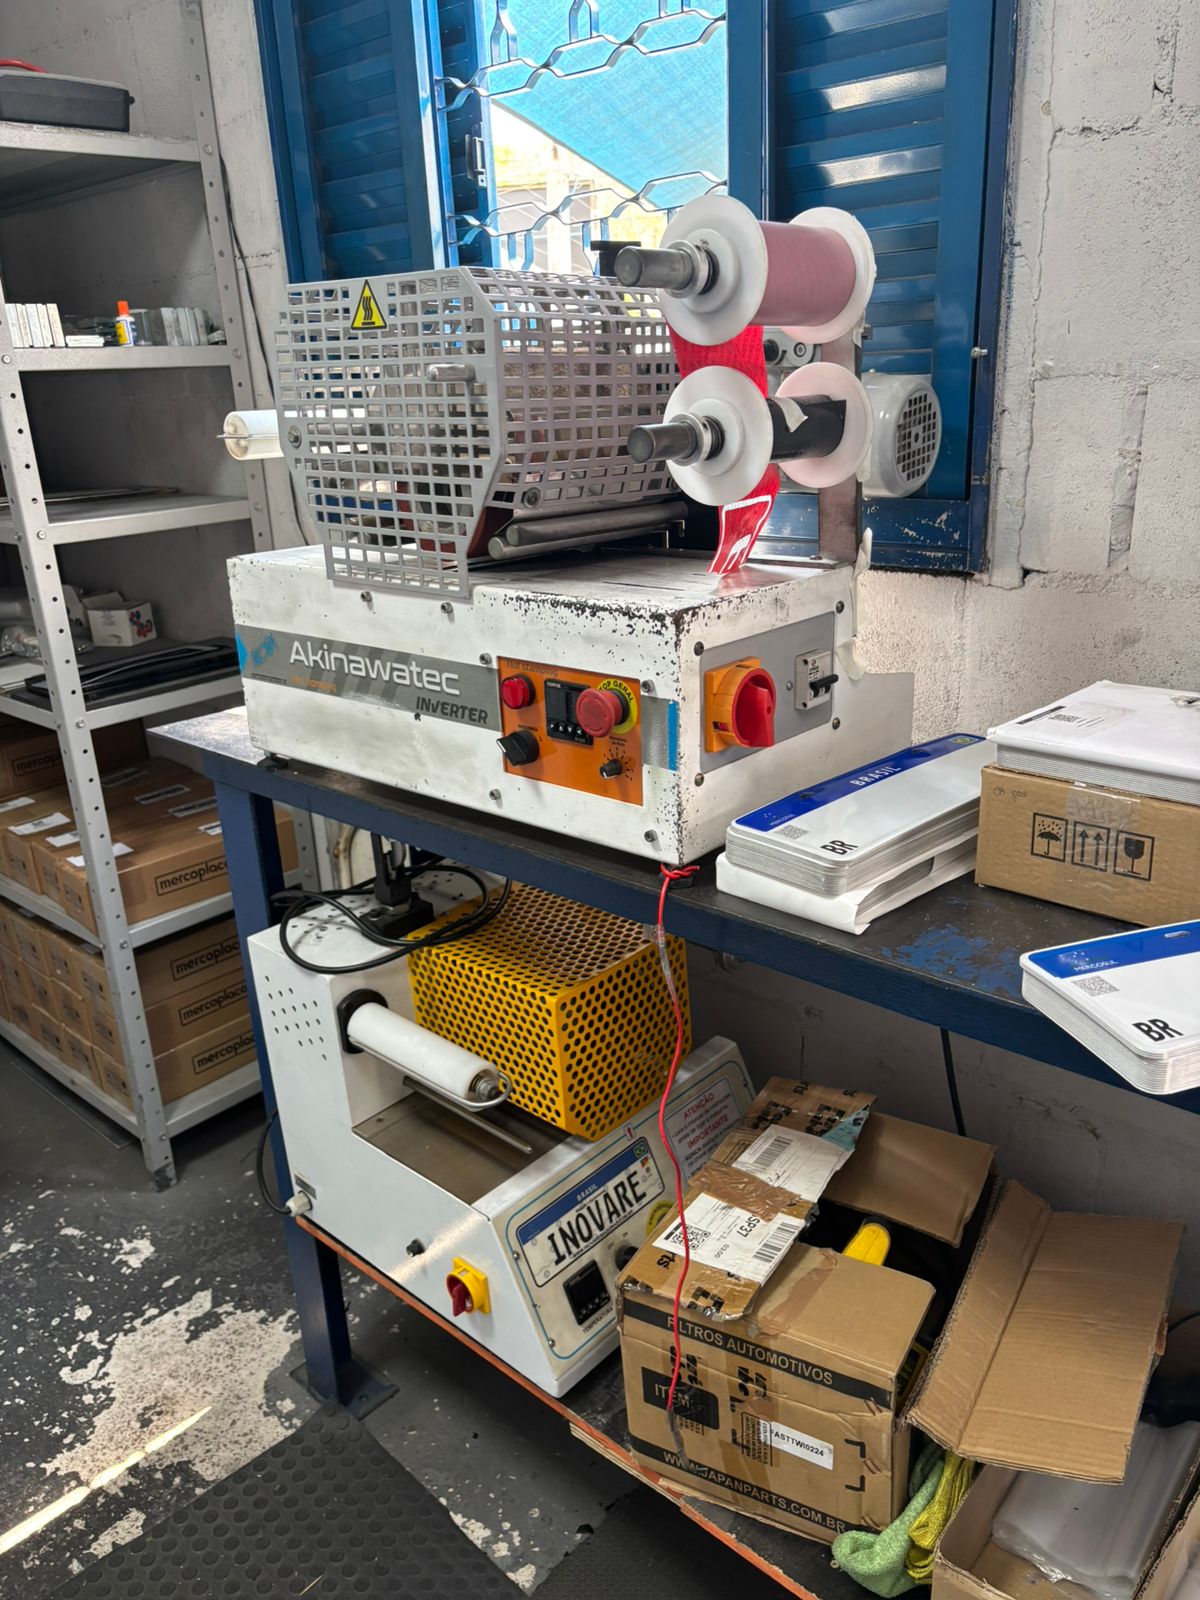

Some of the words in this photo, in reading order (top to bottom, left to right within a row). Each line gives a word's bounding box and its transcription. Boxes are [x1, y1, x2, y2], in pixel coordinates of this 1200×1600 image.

[289, 641, 461, 696] Akinawatec
[599, 680, 611, 692] TOP
[612, 679, 634, 703] GERAL
[416, 696, 489, 724] INVERTER
[850, 766, 901, 787] BRASIL
[820, 839, 859, 857] BR
[160, 860, 228, 890] mercoplac
[1132, 1018, 1185, 1043] BR
[684, 1093, 715, 1119] ATENÇÃO
[687, 1113, 729, 1149] IMPORTANTE
[576, 1184, 598, 1201] BRASIL
[547, 1170, 647, 1266] INOVARE
[736, 1212, 762, 1238] SP37
[667, 1316, 723, 1346] FLTROS
[726, 1337, 834, 1386] AUTOMOTIVOS
[655, 1383, 690, 1409] ITEM
